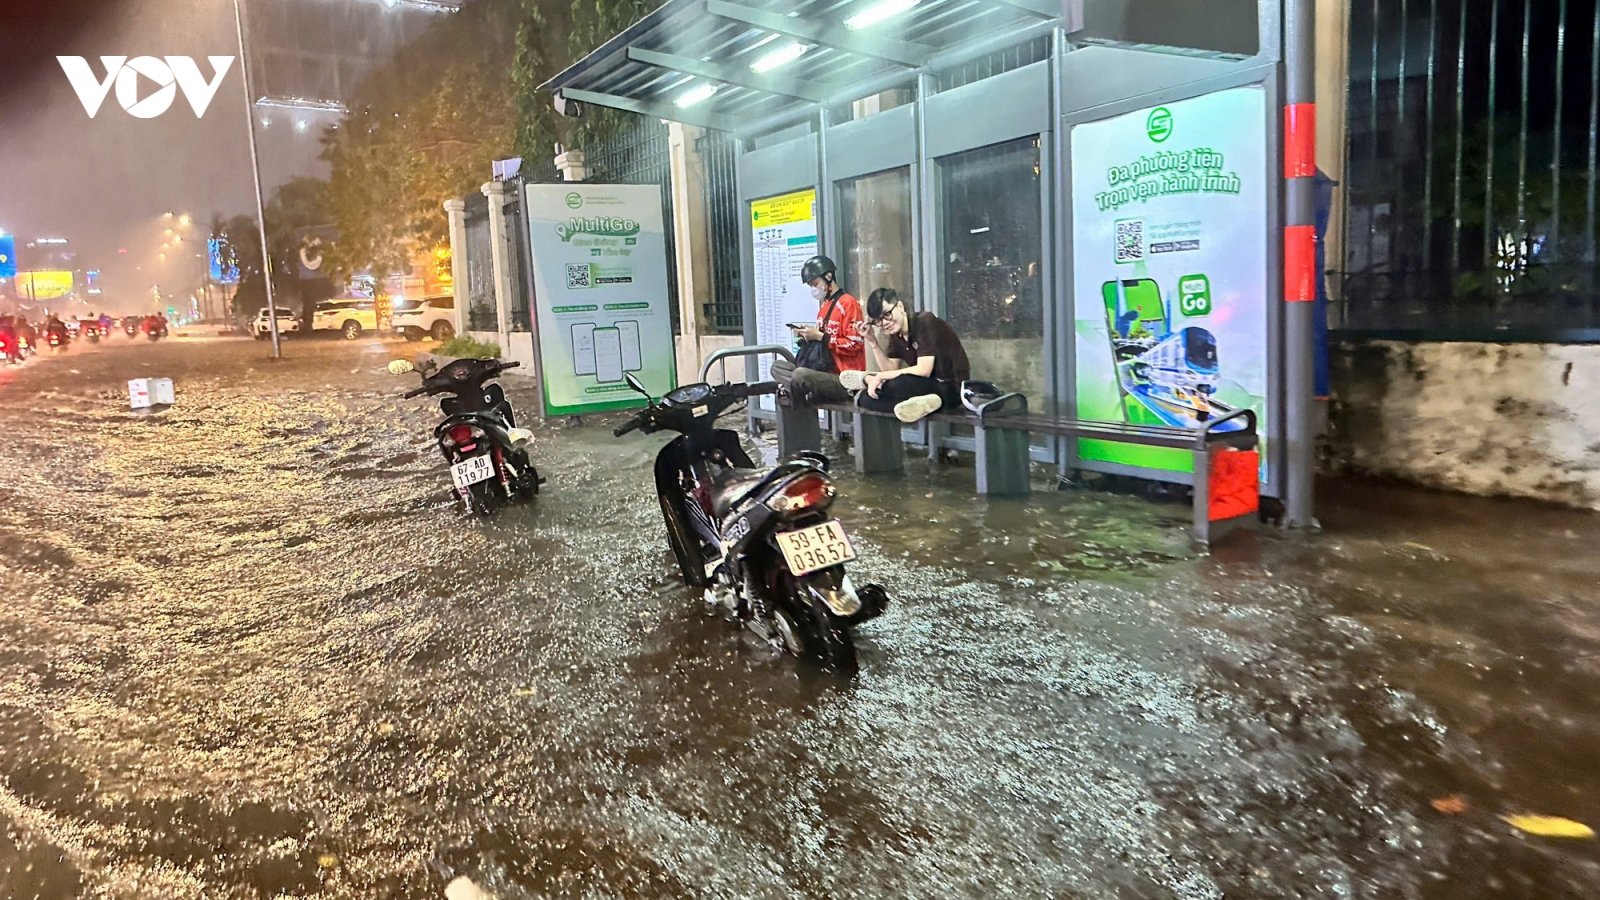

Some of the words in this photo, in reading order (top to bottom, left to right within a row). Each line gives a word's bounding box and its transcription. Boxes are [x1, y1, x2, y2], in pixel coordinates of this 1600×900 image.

[1108, 166, 1130, 186] Đa
[1131, 151, 1190, 182] phương
[1095, 190, 1129, 211] Trọn
[1129, 181, 1158, 203] vẹn
[1159, 171, 1200, 194] hành
[1201, 169, 1241, 194] trình
[569, 215, 635, 232] MultiGo
[1182, 293, 1207, 311] Go
[457, 457, 486, 475] 67-AD
[789, 525, 839, 551] 59-FA
[794, 541, 852, 571] 036.52
